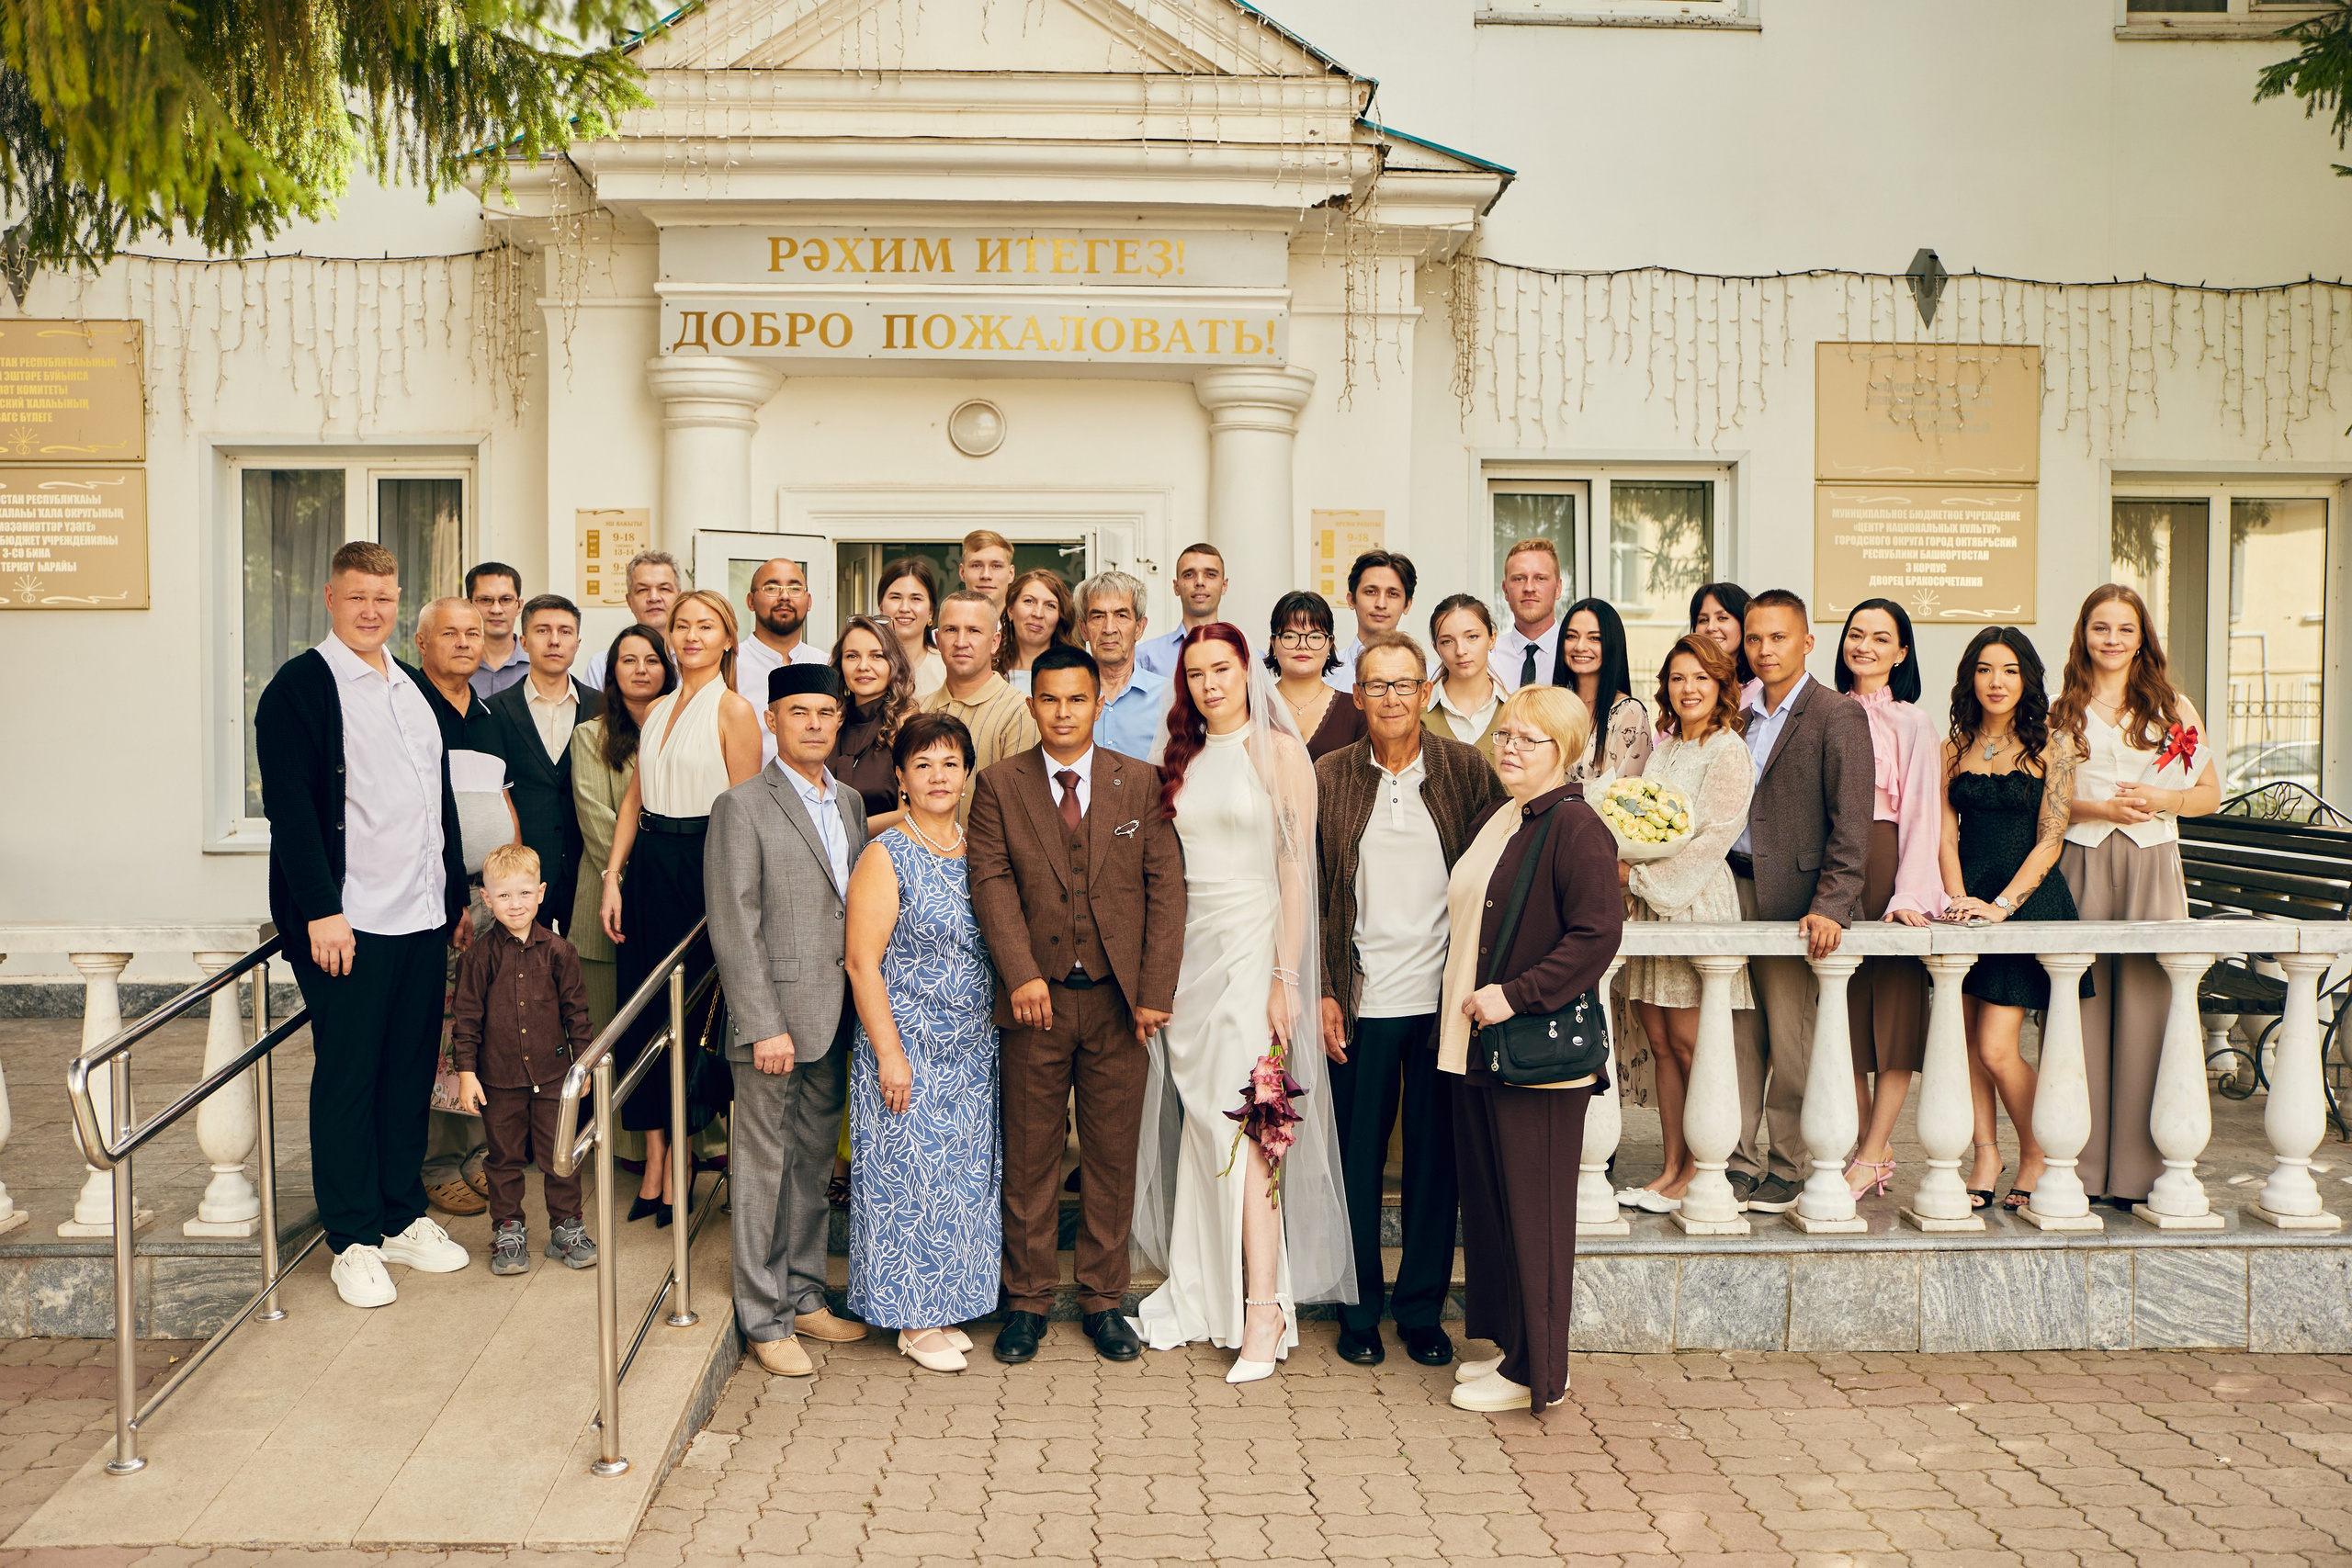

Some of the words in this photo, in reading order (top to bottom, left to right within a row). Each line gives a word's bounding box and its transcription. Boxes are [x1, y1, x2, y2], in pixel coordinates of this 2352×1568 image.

[977, 236, 1185, 278] ИТЕГЕҘ!
[673, 310, 854, 354] ДОБРО
[882, 313, 1275, 355] ПОЖАЛОВАТЬ!
[43, 369, 89, 381] БУЙЫНСА
[17, 385, 68, 395] КОМИТЕТЫ
[0, 412, 17, 423] АГС
[0, 494, 24, 504] СТАН
[1832, 509, 1907, 520] МУНИЦИПАЛЬНОЕ
[1909, 510, 1963, 521] БЮДЖЕТНОЕ
[1965, 511, 2020, 522] УЧРЕЖДЕНИЕ
[1854, 522, 1884, 533] «ЦЕНТР
[1886, 523, 1958, 534] НАЦИОНАЛЬНЫХ
[1960, 524, 2001, 534] КУЛЬТУР»
[0, 536, 40, 547] БЮДЖЕТ
[613, 533, 635, 542] 9-18
[1347, 533, 1369, 542] 9-18
[1835, 536, 1891, 547] ГОРОДСКОГО
[1893, 536, 1924, 546] ОКРУГА
[1926, 536, 1954, 548] ГОРОД
[1955, 536, 2018, 547] ОКТЯБРЬСКИЙ
[26, 547, 51, 558] БИНА
[1862, 548, 1918, 559] РЕСПУБЛИКИ
[1919, 549, 1989, 560] БАШКОРТОСТАН
[1905, 562, 1912, 573] 3
[1913, 563, 1947, 573] КОРПУС
[1869, 575, 1905, 587] ДВОРЕЦ
[1905, 576, 1983, 587] БРАКОСОЧЕТАНИЯ
